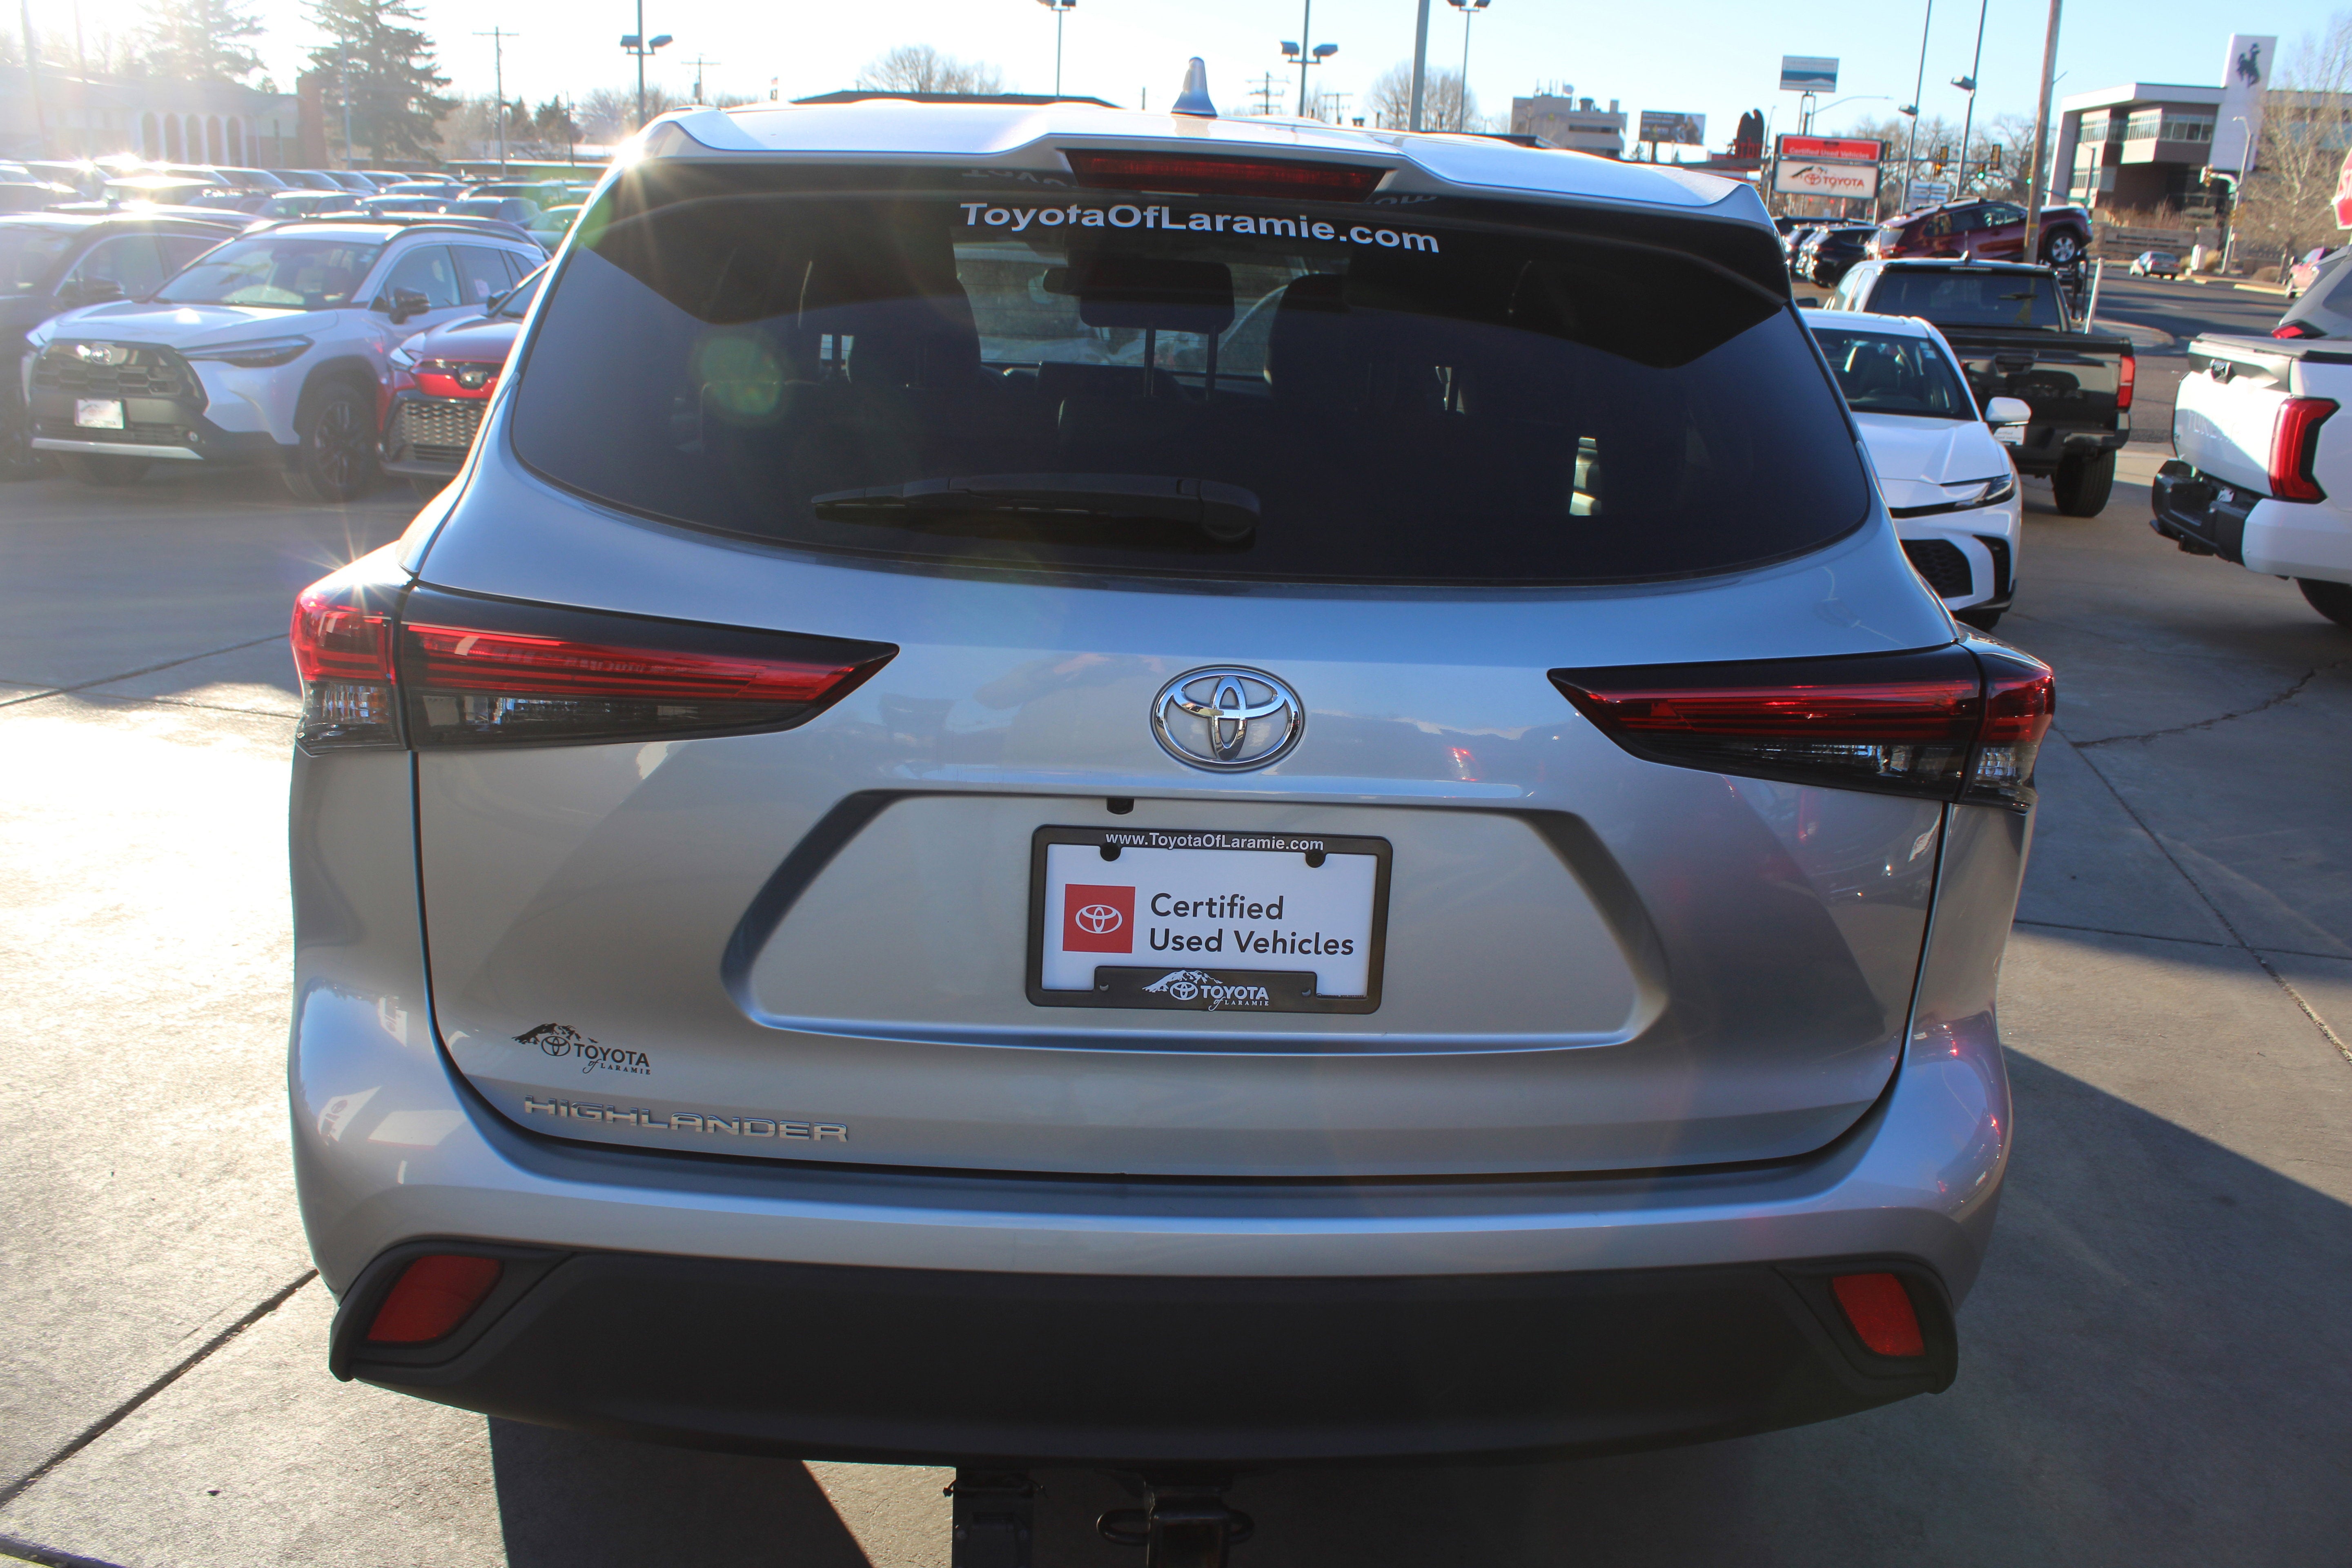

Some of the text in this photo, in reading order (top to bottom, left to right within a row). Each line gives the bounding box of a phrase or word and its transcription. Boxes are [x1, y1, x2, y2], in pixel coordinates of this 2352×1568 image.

[1823, 176, 1864, 187] TOYOTA
[960, 203, 1439, 253] ToyotaOfLaramie.com
[1105, 832, 1324, 851] www.ToyotaOfLaramie.com
[1150, 893, 1283, 920] Certified
[1150, 928, 1354, 956] Used Vehicles
[1200, 985, 1269, 1000] TOYOTA
[1208, 996, 1224, 1011] of
[574, 1043, 649, 1067] TOYOTA
[582, 1059, 650, 1075] of LARAMIE
[524, 1095, 849, 1143] HIGHLANDER
